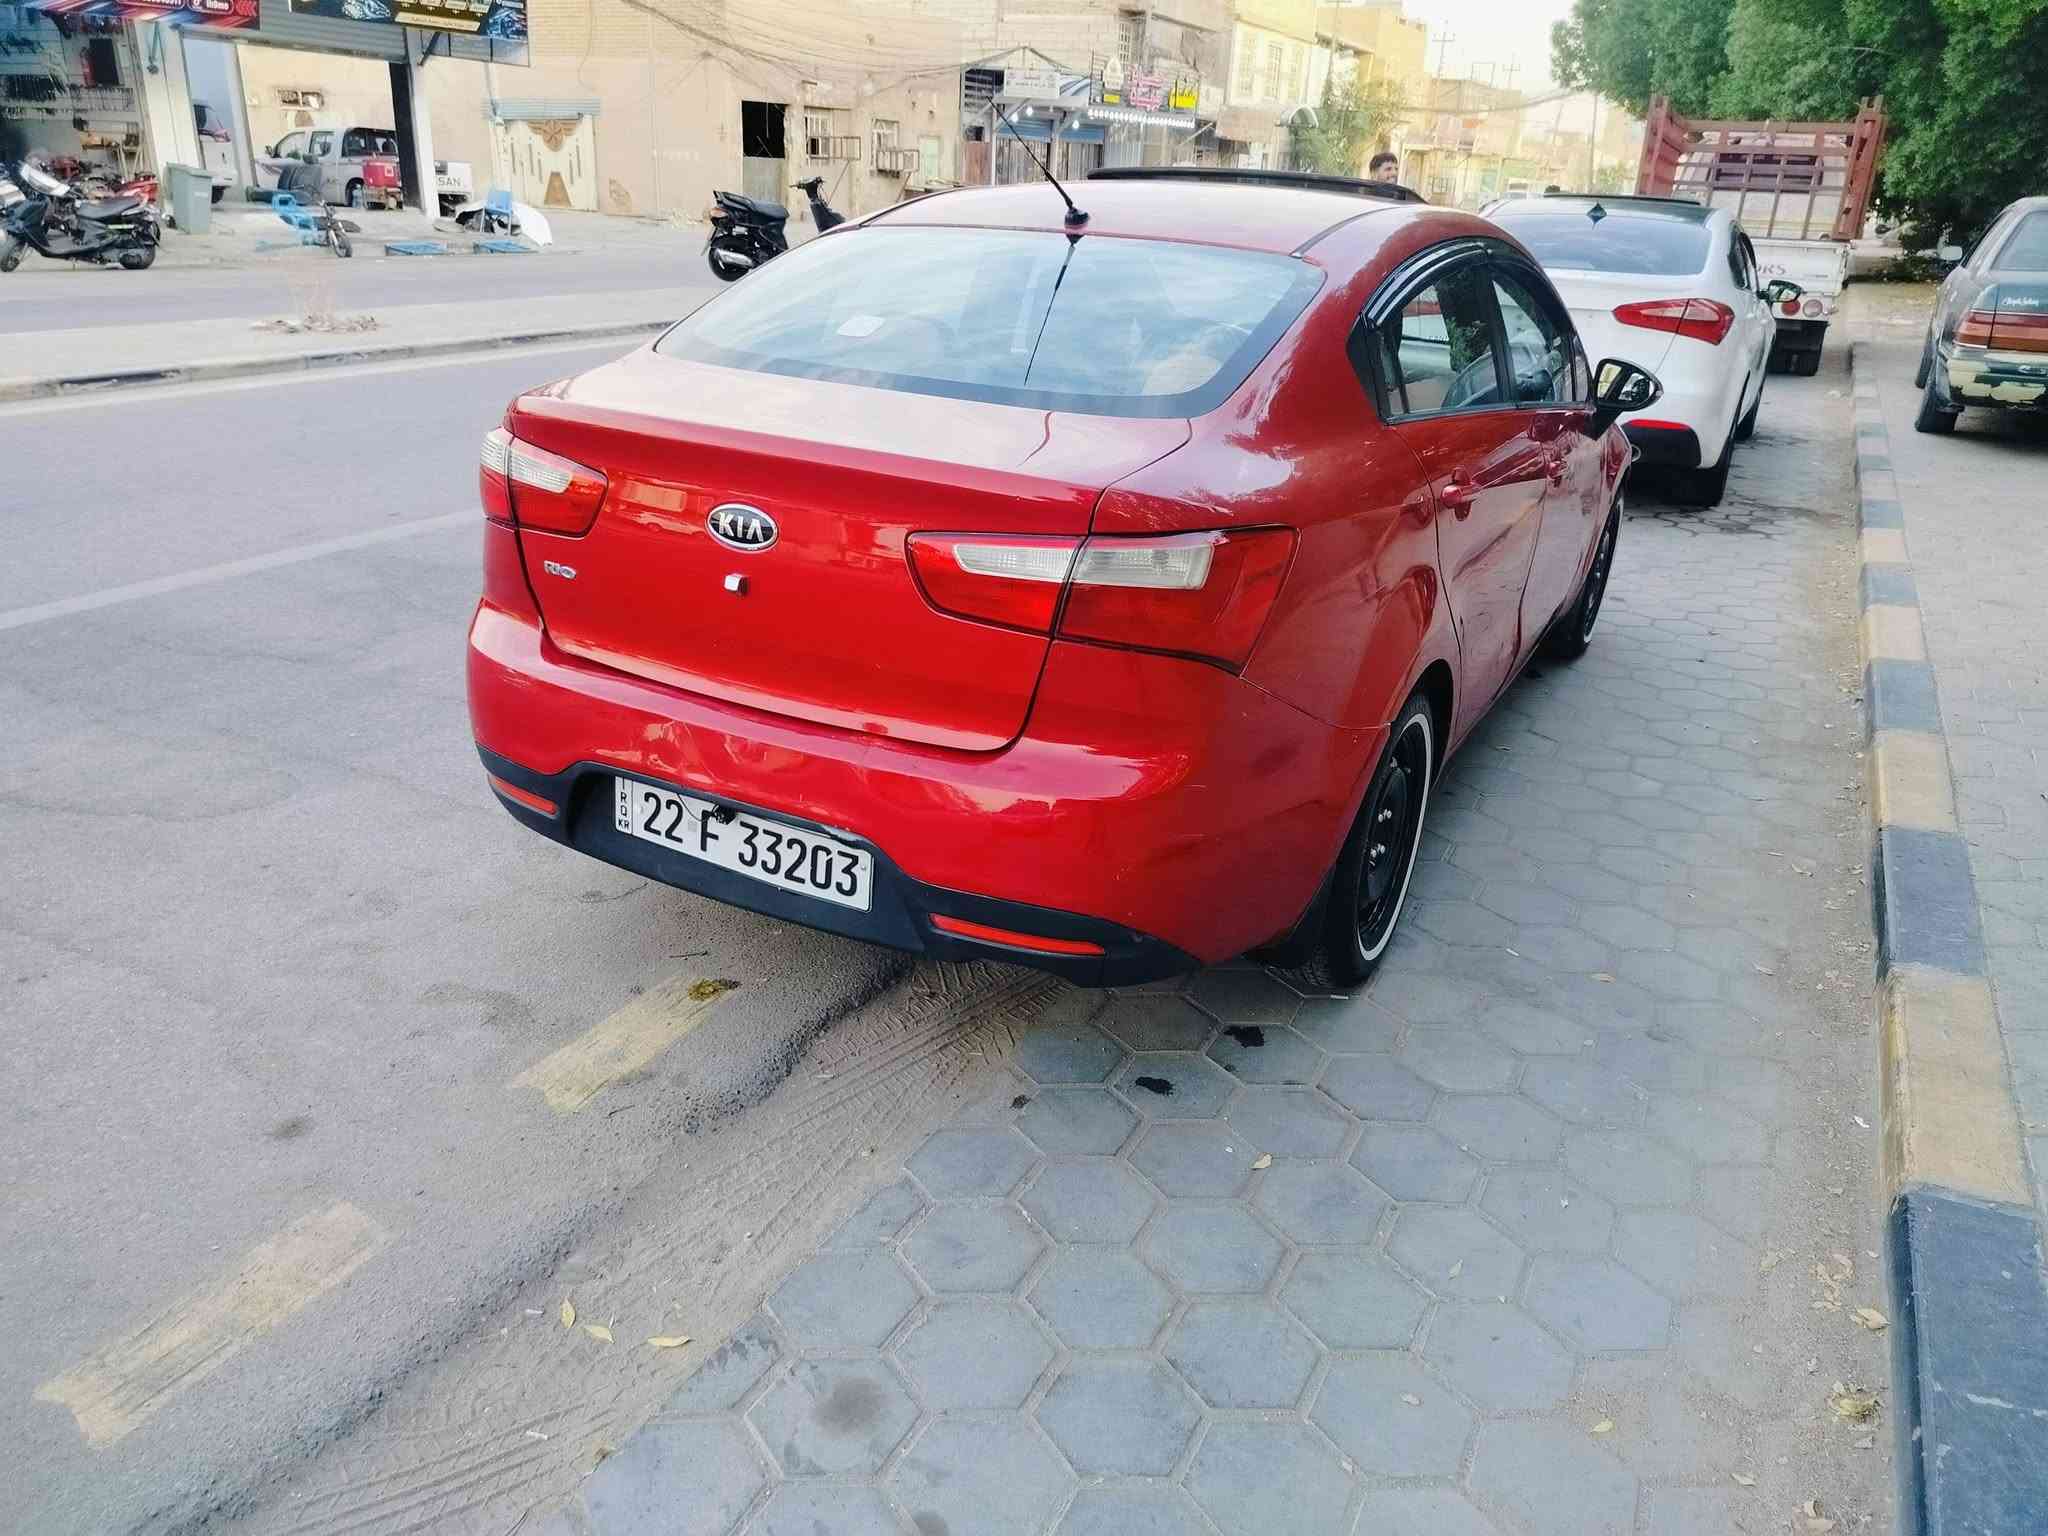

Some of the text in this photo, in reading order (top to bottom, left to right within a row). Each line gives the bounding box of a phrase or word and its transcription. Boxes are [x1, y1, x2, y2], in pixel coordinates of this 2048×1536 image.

[718, 511, 764, 543] KIA
[543, 559, 577, 580] RIO
[643, 792, 860, 897] 22 F 33203
